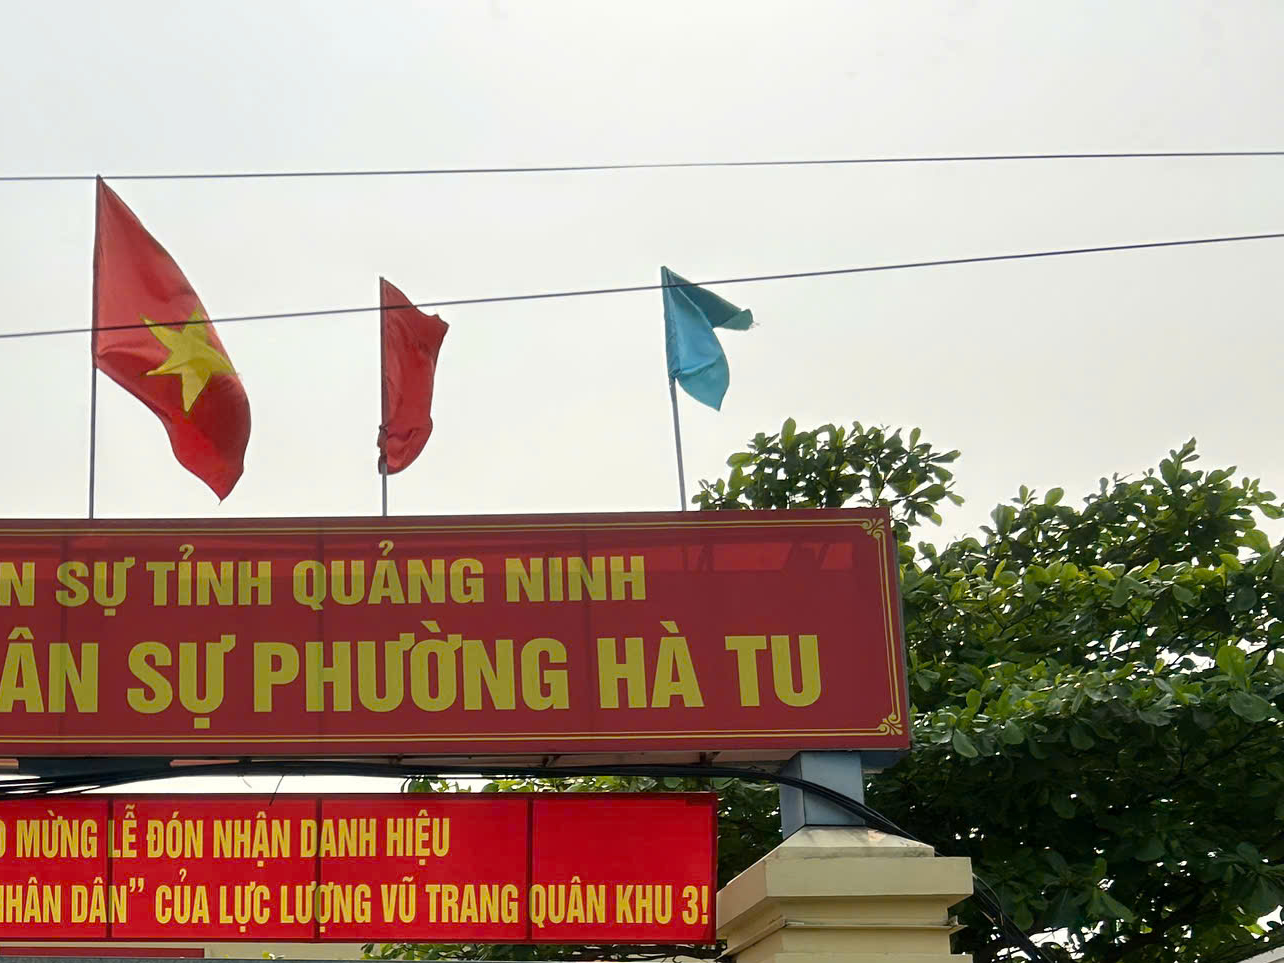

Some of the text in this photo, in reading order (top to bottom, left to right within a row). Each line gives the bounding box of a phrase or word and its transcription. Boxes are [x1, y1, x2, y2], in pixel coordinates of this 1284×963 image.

[55, 556, 136, 617] SỰ
[146, 543, 272, 606] TỈNH
[292, 540, 484, 611] QUẢNG
[506, 555, 647, 602] NINH
[127, 634, 236, 730] SỰ
[254, 620, 570, 713] PHƯỜNG
[597, 620, 704, 710] HÀ
[724, 634, 823, 708] TU
[16, 813, 98, 859] MỪNG
[108, 803, 137, 858] LỄ
[146, 812, 204, 858] ĐÓN
[212, 810, 292, 867] NHẬN
[300, 819, 377, 858] DANH
[385, 810, 450, 866] HIỆU
[71, 875, 145, 924] DÂN”
[155, 868, 211, 925] CỦA
[219, 881, 271, 933] LỰC
[280, 880, 372, 934] LƯỢNG
[380, 875, 416, 924] VŨ
[425, 884, 519, 924] TRANG
[529, 875, 607, 929] QUÂN
[616, 884, 671, 925] KHU
[681, 884, 710, 925] 3!
